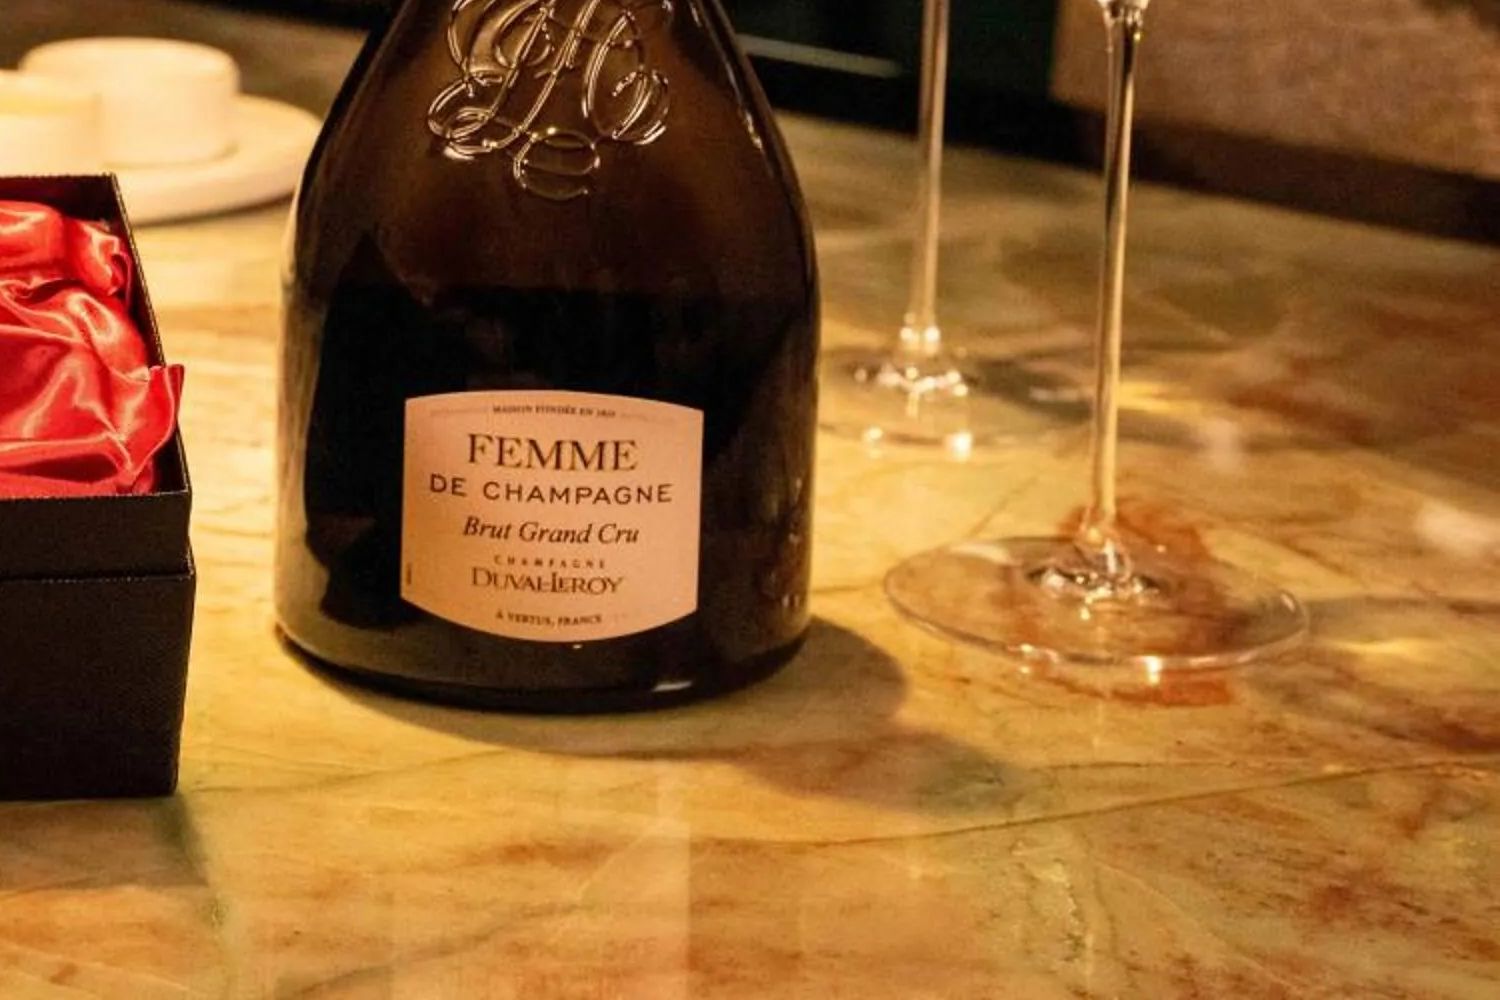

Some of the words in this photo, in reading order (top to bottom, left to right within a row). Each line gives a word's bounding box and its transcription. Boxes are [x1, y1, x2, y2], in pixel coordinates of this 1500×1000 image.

[467, 433, 638, 471] FEMME
[430, 473, 467, 497] DE
[482, 481, 673, 505] CHAMPAGNE
[462, 515, 510, 540] Brut
[518, 521, 592, 544] Grand
[597, 523, 640, 544] Cru
[493, 555, 605, 568] CHAMPAGNE
